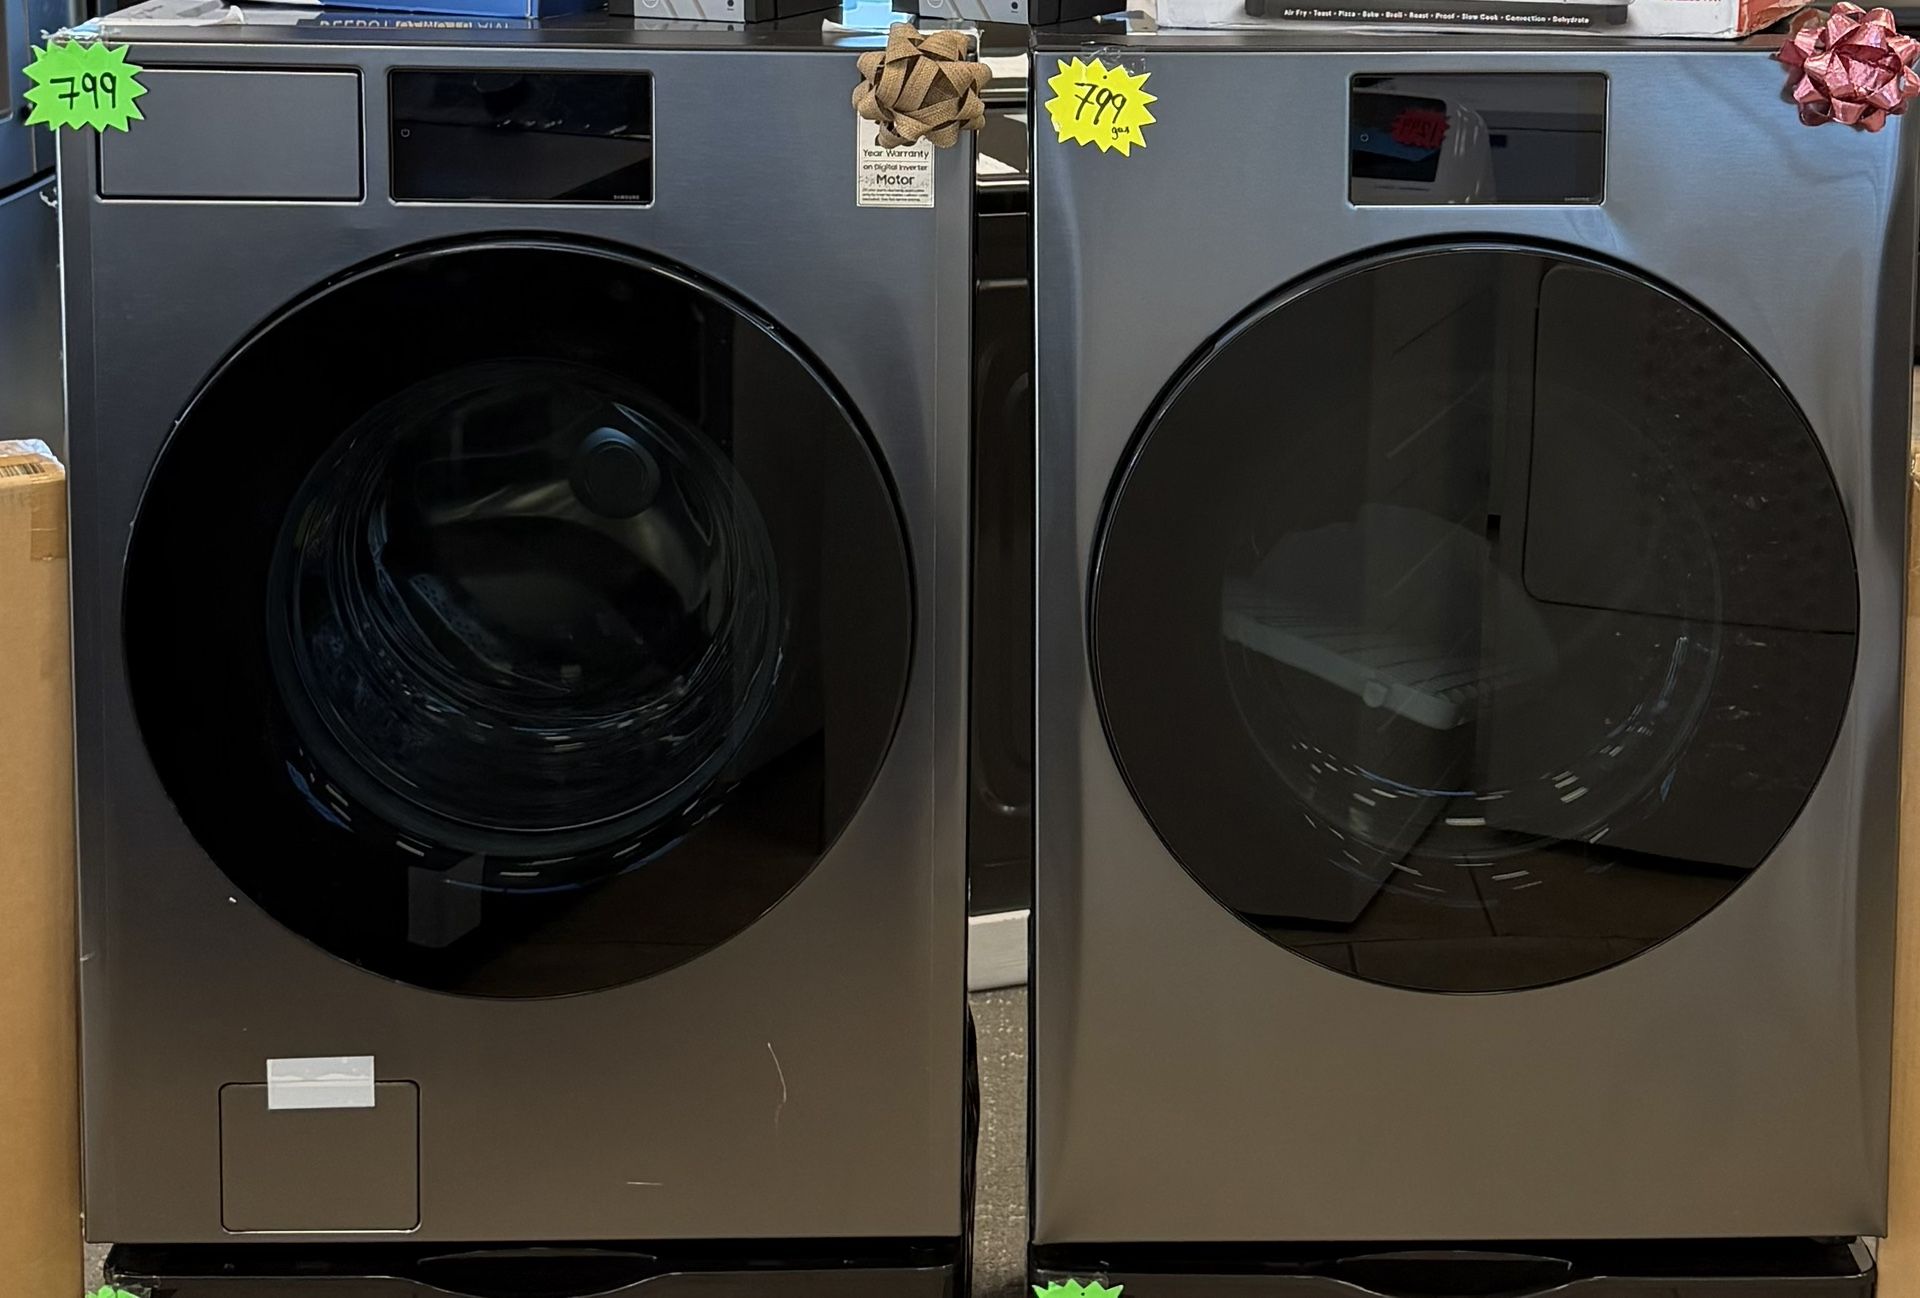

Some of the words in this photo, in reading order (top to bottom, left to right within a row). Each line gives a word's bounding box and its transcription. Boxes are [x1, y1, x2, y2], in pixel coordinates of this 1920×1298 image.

[1295, 9, 1307, 17] Fry
[1313, 9, 1332, 17] Toast
[1362, 10, 1379, 18] Bake
[1409, 11, 1429, 19] Roast
[1505, 14, 1546, 22] Convection
[1552, 15, 1589, 24] Dehydrate
[49, 72, 117, 110] 799
[1074, 82, 1127, 125] 799
[1111, 126, 1130, 140] gas
[863, 149, 883, 157] Year
[886, 149, 929, 160] Warranty
[874, 163, 898, 172] Digital
[899, 163, 928, 171] Inverter
[876, 173, 915, 185] Motor
